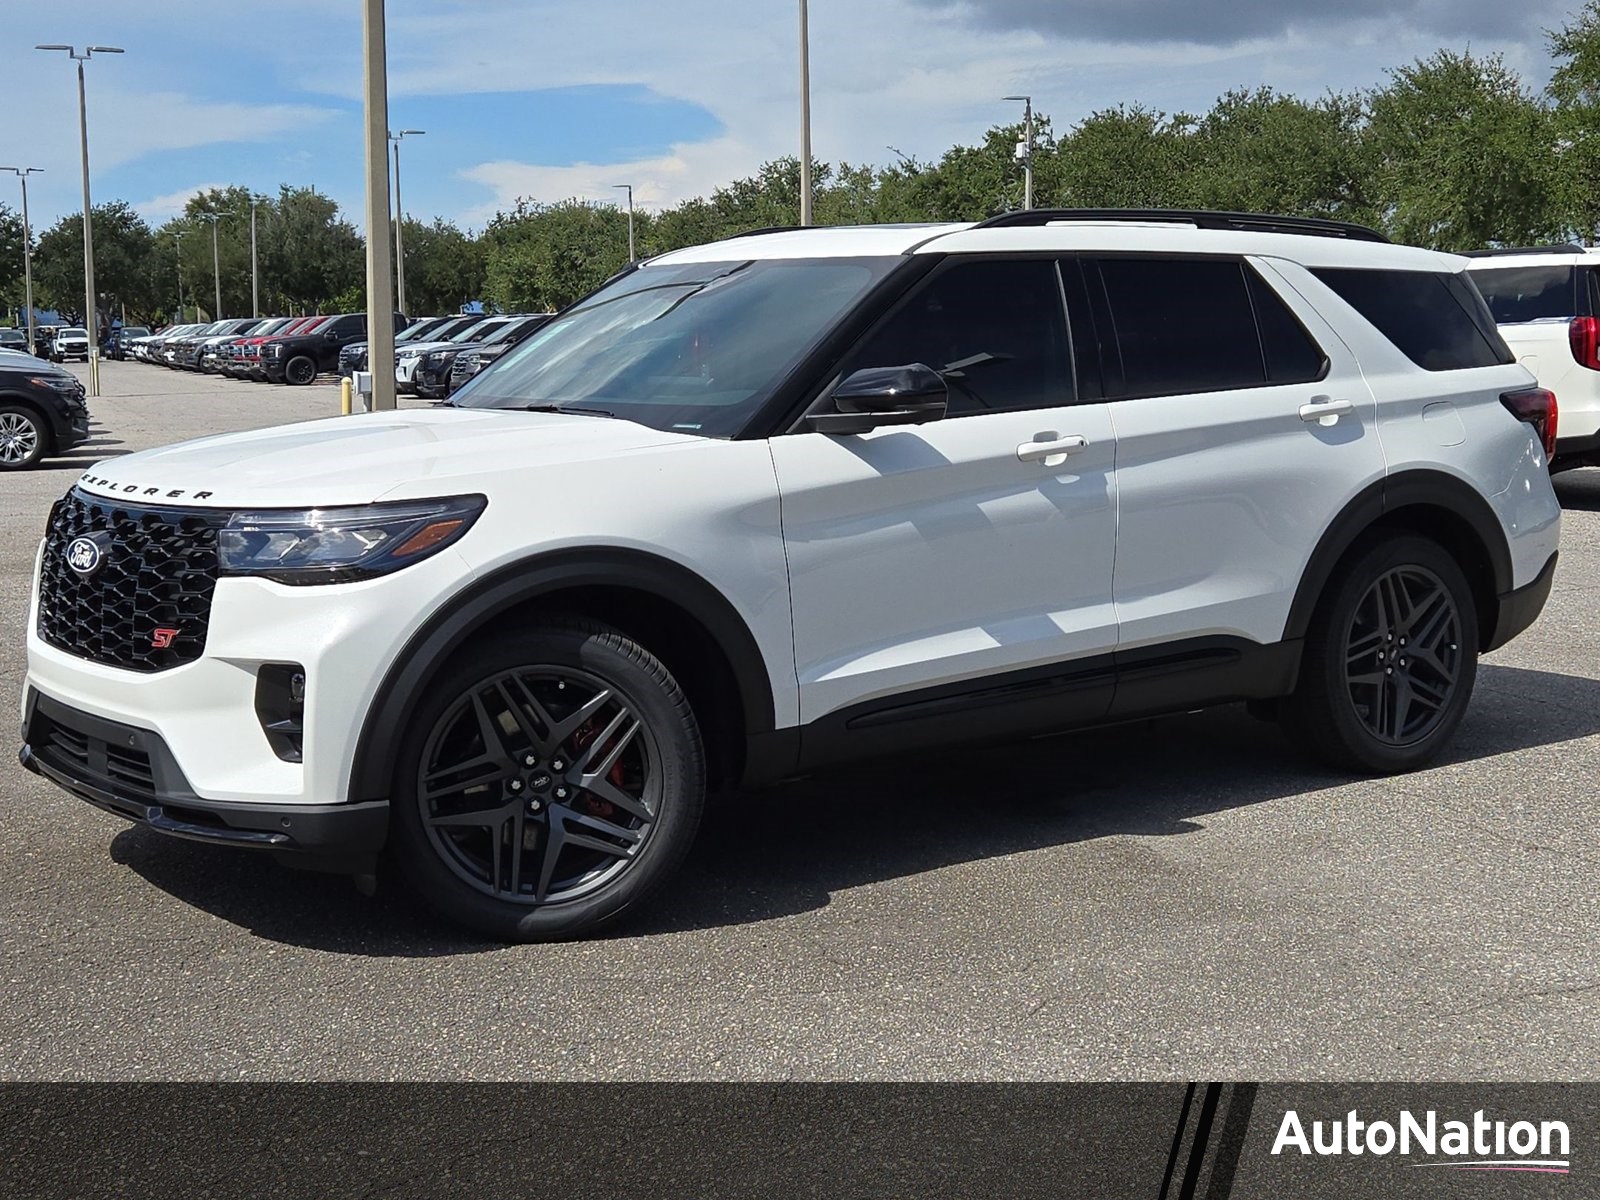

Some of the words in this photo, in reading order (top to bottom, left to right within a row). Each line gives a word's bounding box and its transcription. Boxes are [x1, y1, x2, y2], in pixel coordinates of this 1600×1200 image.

[81, 474, 213, 499] EXPLORER
[70, 541, 94, 568] Ford
[151, 628, 180, 648] ST
